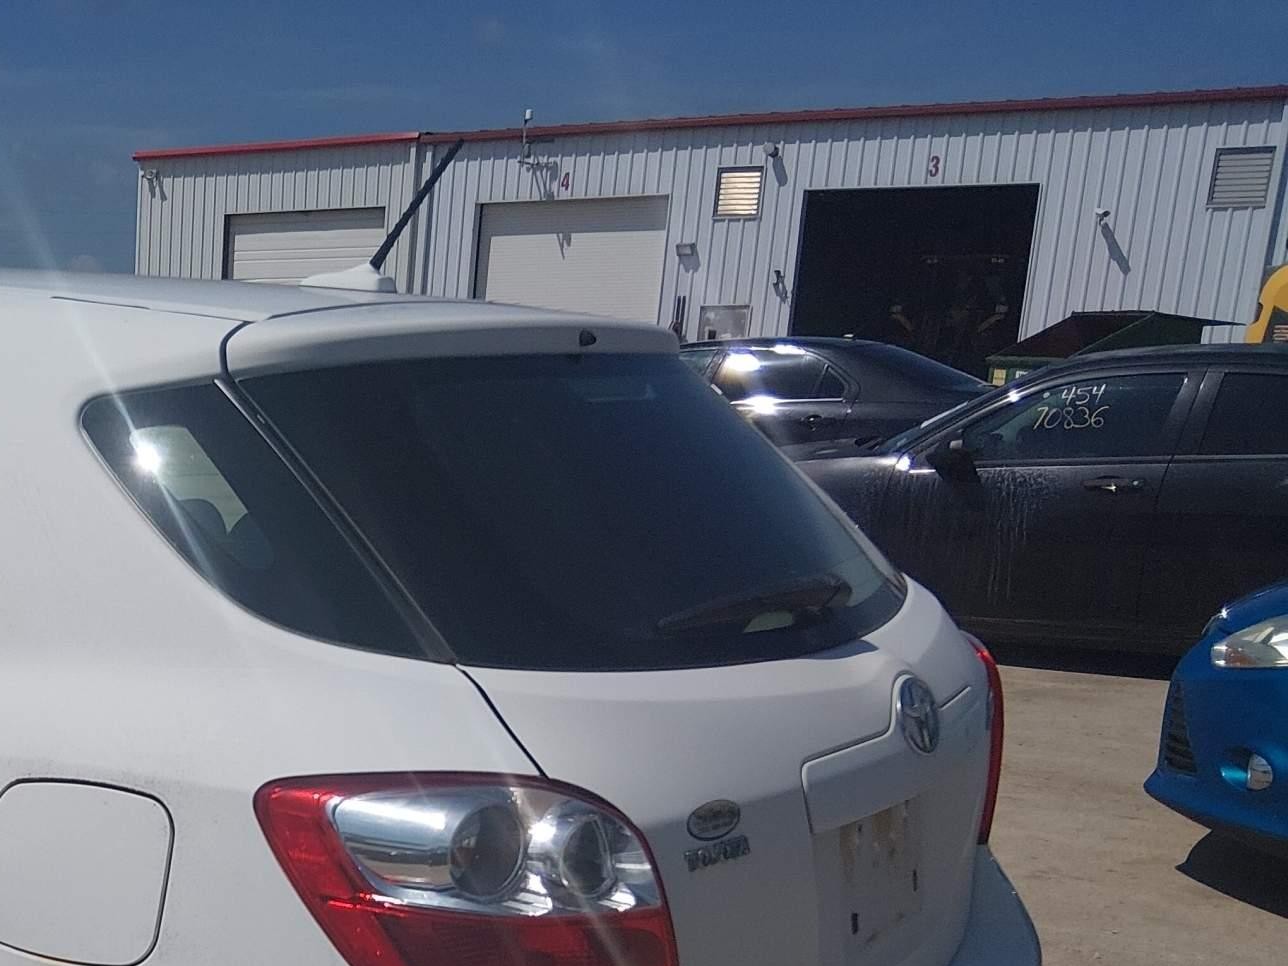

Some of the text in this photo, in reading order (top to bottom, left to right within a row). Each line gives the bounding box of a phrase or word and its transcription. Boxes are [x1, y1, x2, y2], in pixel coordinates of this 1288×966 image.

[929, 155, 940, 177] 3
[561, 171, 570, 191] 4
[1061, 383, 1106, 405] 454
[1032, 405, 1110, 430] 70836
